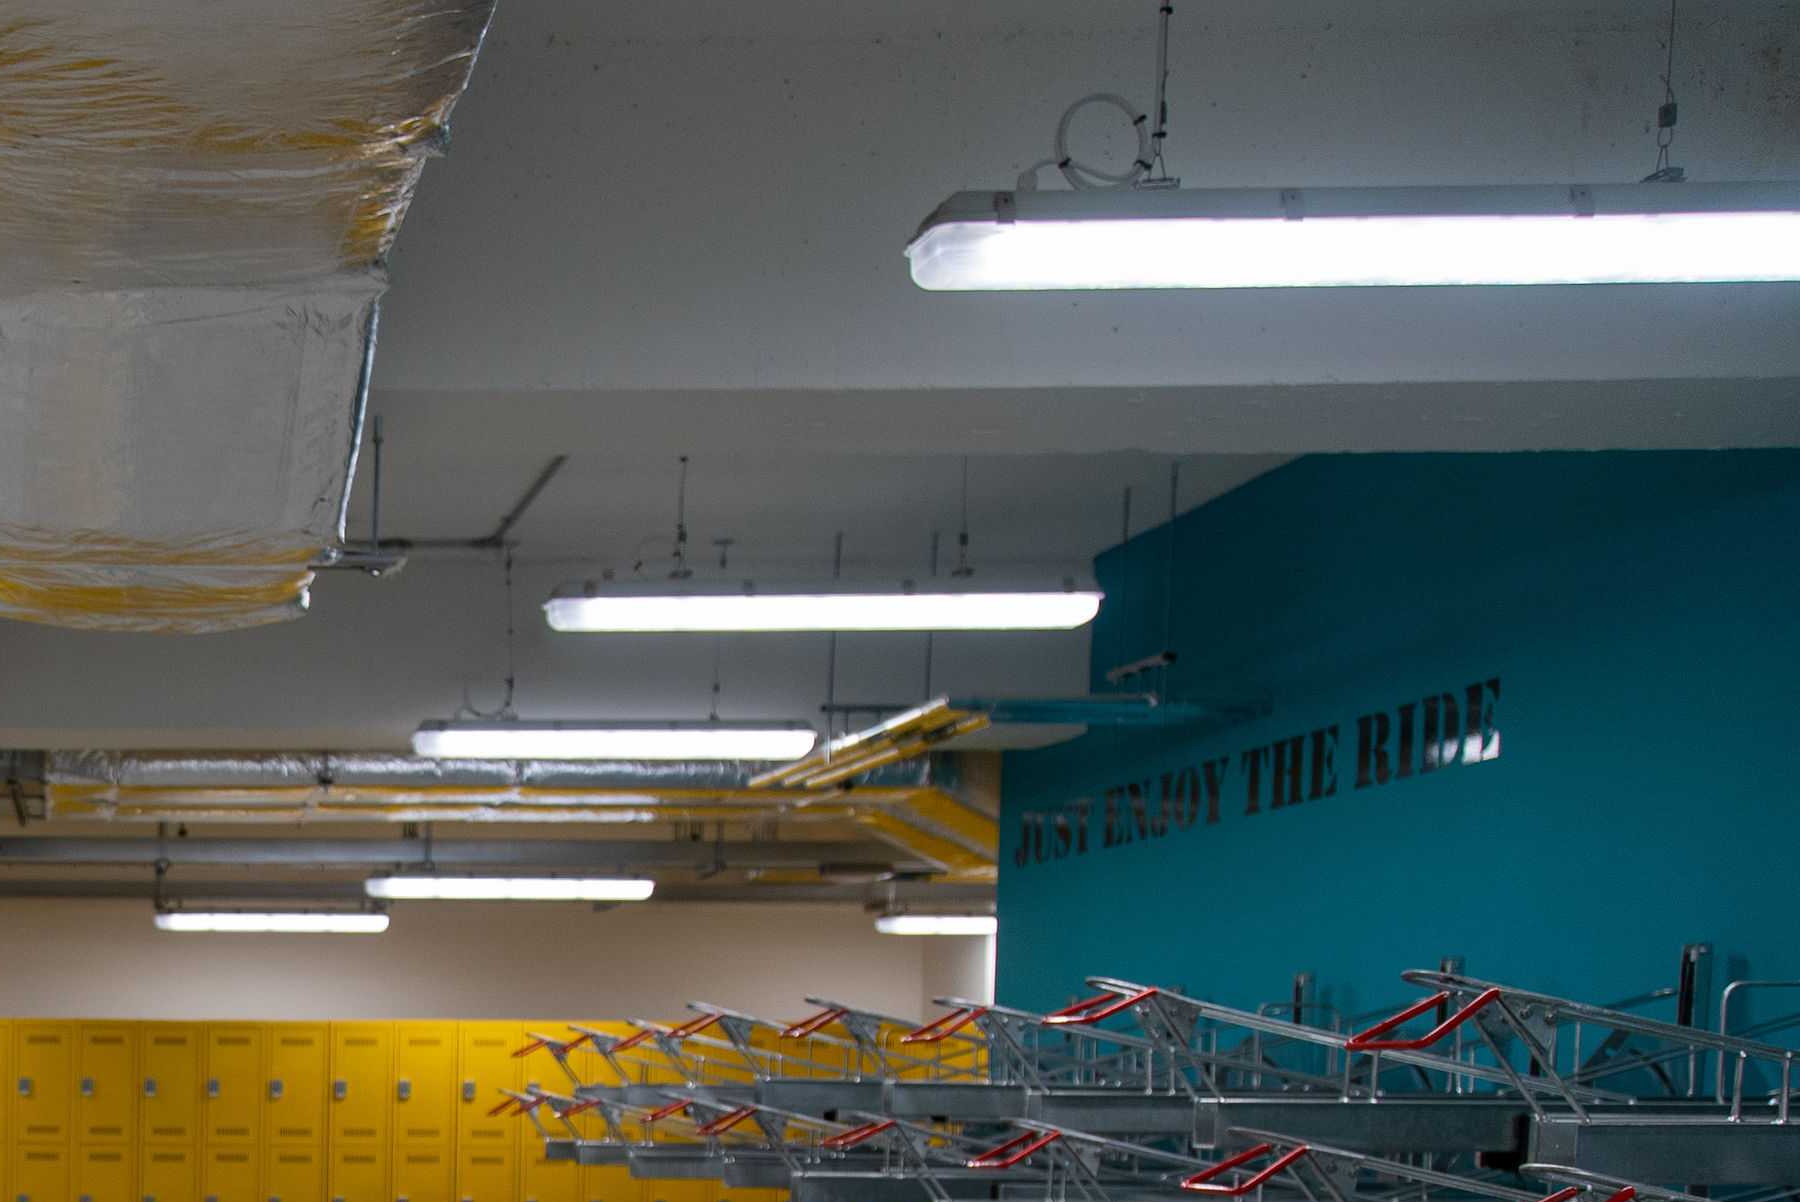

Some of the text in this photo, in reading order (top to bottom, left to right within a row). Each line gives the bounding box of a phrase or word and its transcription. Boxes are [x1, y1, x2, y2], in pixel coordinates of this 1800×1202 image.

[1014, 677, 1500, 868] JUST ENJOY THE RIDE
